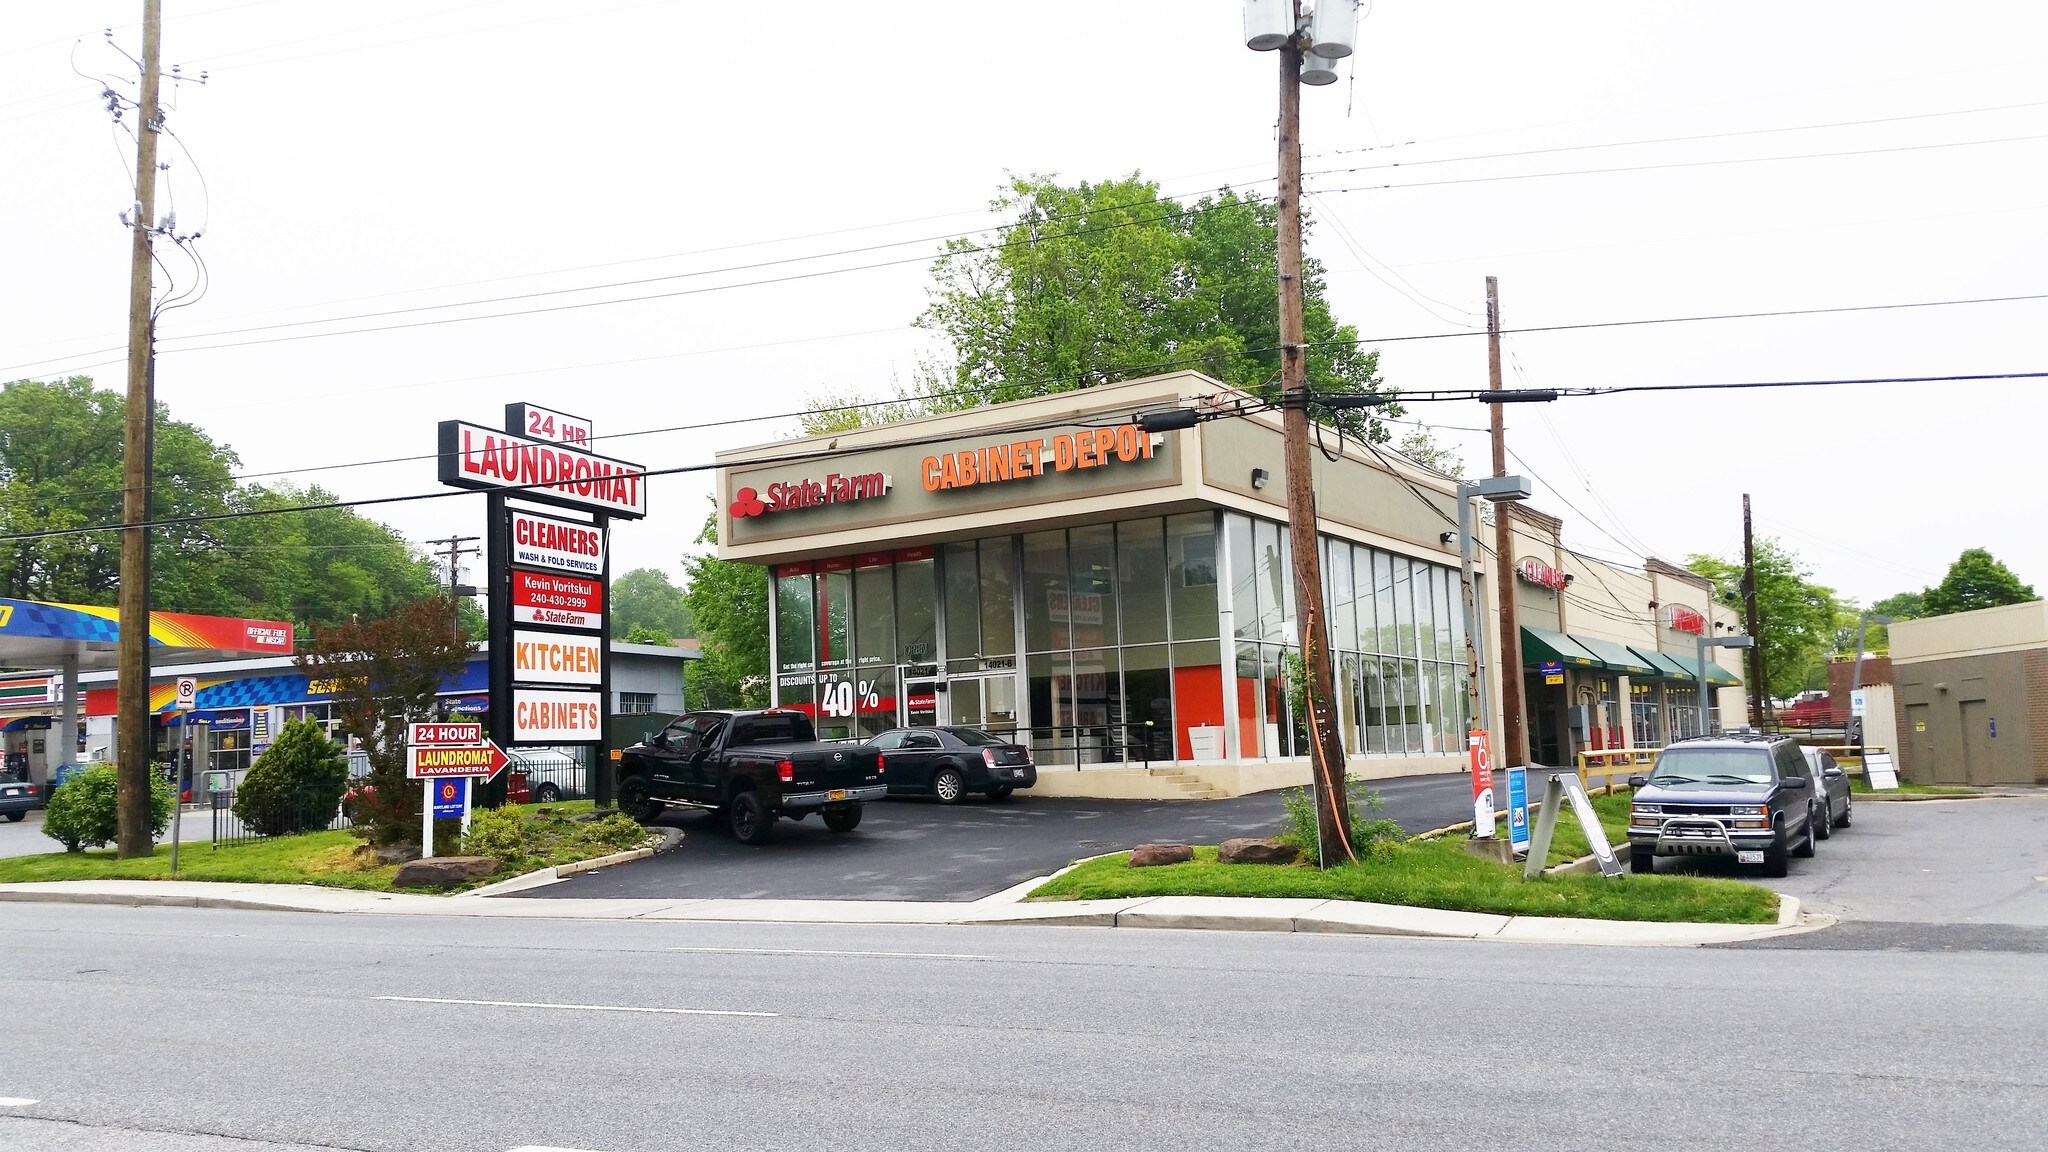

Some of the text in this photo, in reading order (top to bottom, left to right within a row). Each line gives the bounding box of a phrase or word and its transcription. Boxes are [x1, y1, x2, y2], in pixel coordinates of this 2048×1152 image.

[528, 411, 587, 446] 24 HR
[922, 425, 1153, 492] CABINET DEPOT
[464, 430, 640, 507] LAUNDROMAT
[516, 518, 599, 557] CLEANERS
[519, 551, 598, 571] WASH & FOLD SERVICES
[525, 576, 592, 595] Kevin Voritskul
[531, 593, 587, 608] 240-430-2999
[517, 642, 599, 673] KITCHEN
[984, 660, 1012, 669] 14021-B
[780, 673, 838, 687] DISCOUNTS UP TO
[517, 701, 598, 730] CABINETS
[418, 727, 477, 741] 24 HOUR
[418, 750, 495, 766] LAUNDROMAT
[420, 766, 491, 774] LAVANDERIA
